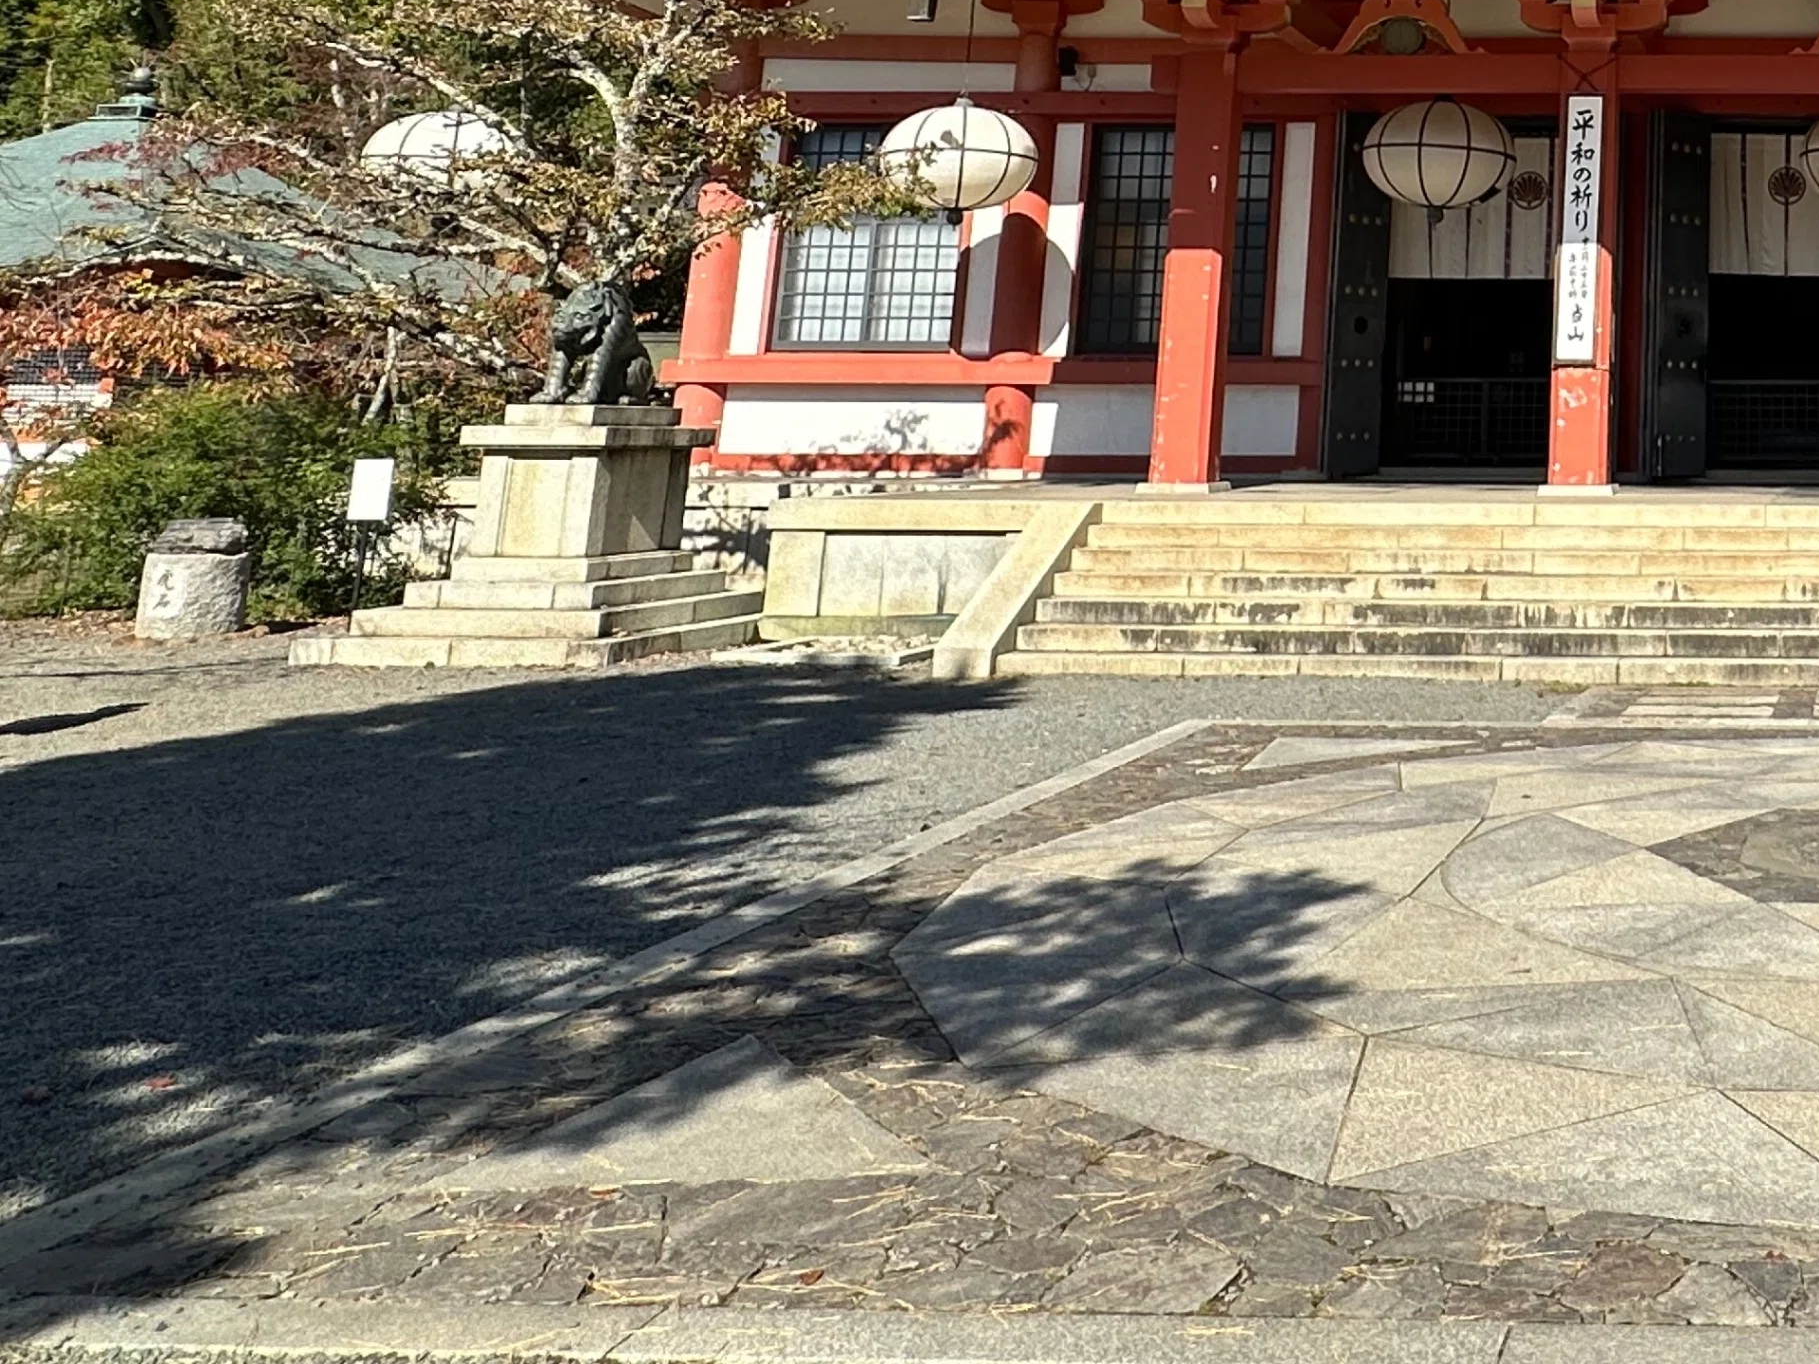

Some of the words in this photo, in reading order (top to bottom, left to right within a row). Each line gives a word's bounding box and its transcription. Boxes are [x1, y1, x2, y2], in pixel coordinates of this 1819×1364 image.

[1570, 109, 1595, 232] 平和の祈り
